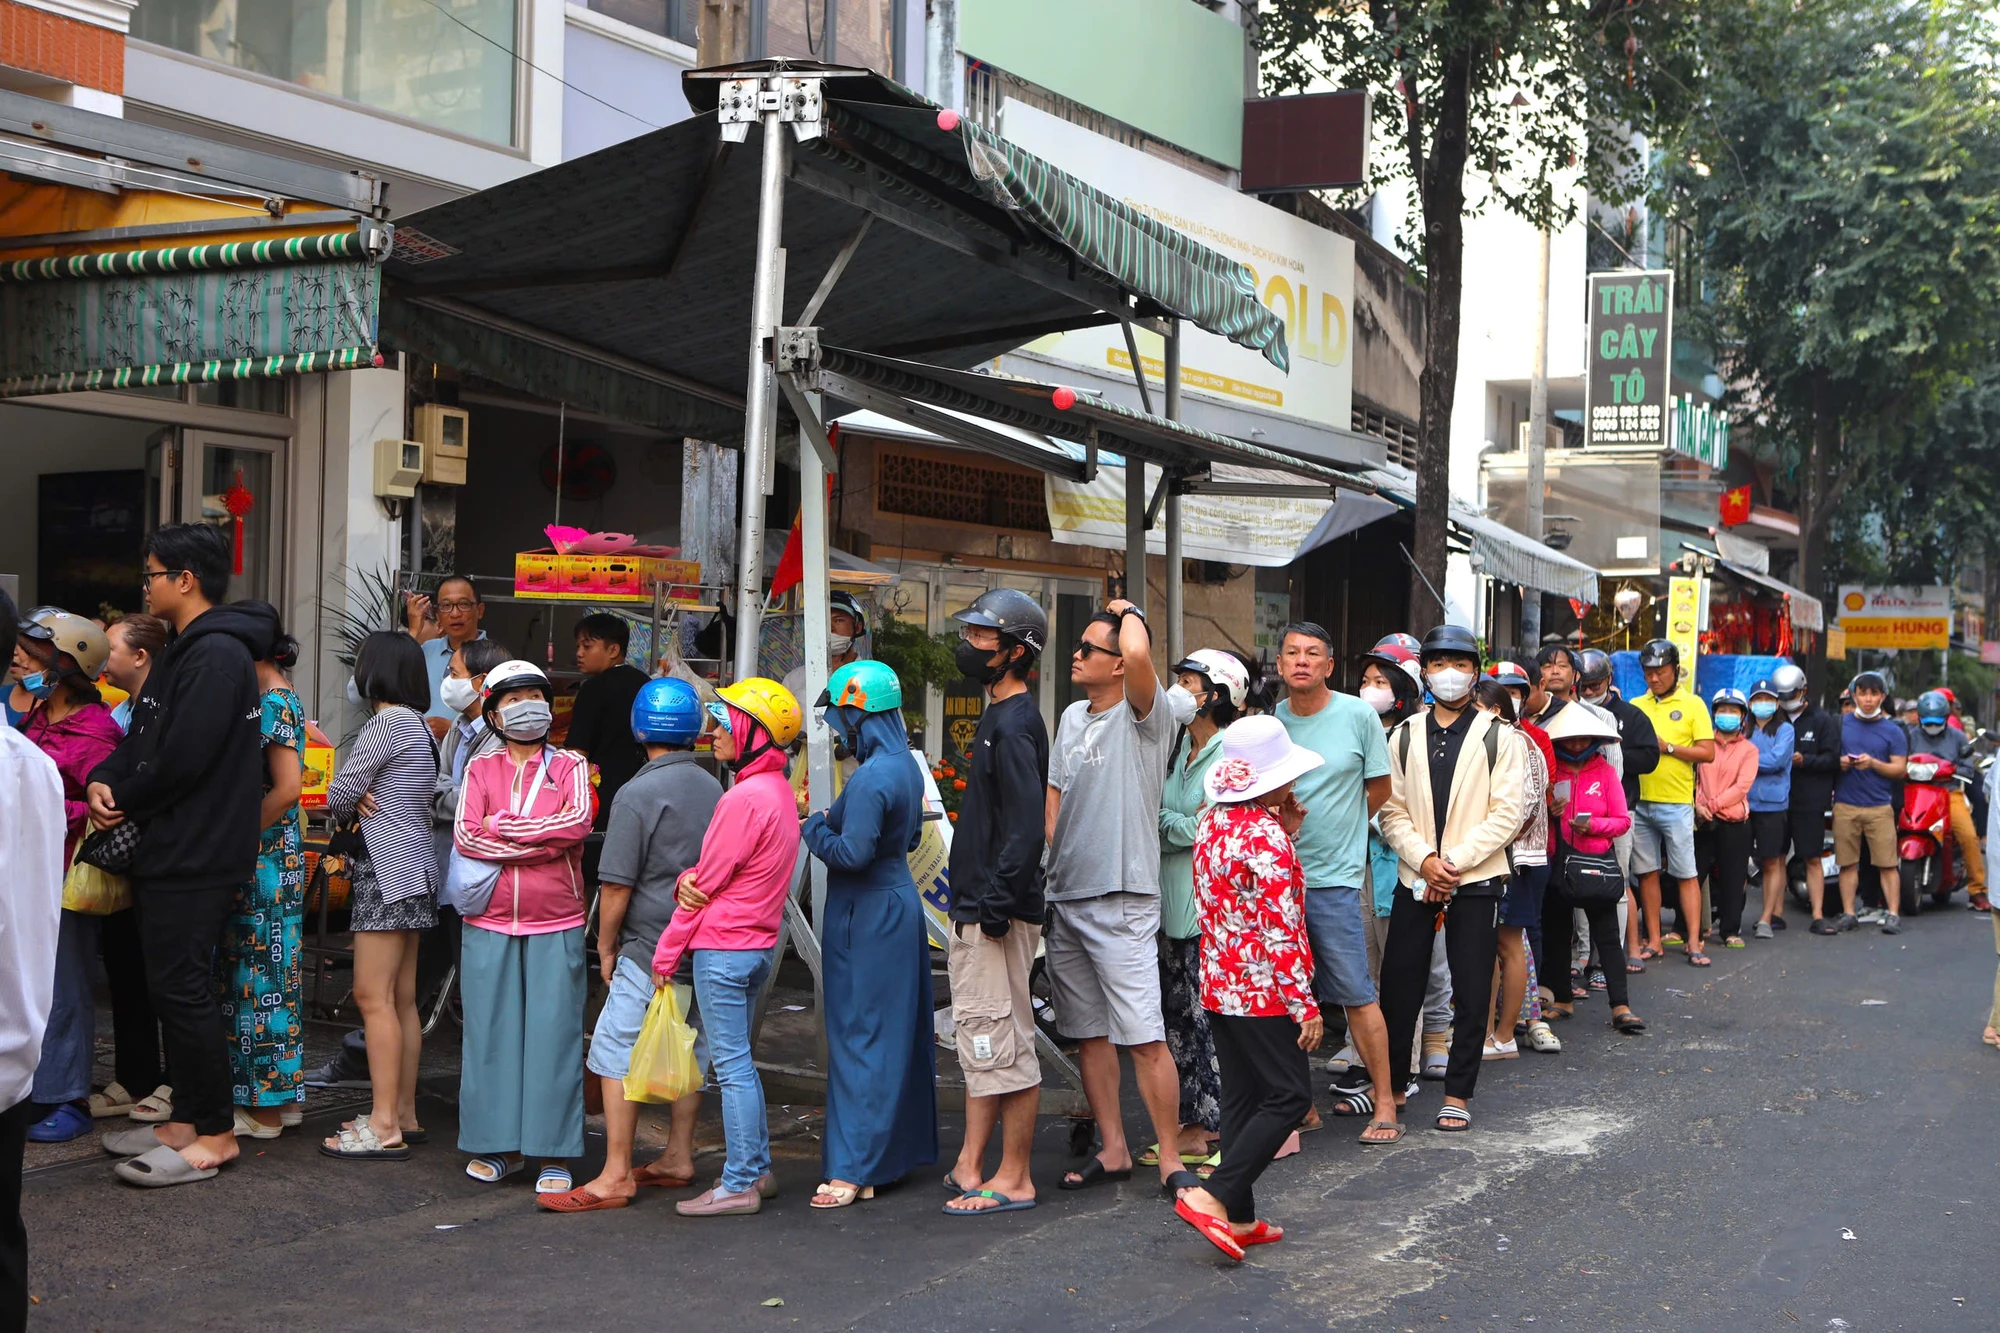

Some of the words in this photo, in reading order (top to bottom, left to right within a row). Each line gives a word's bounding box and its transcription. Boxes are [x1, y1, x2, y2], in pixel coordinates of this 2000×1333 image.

[1241, 262, 1347, 367] OLD
[1598, 277, 1664, 315] TRÁI
[1600, 322, 1658, 360] CÂY
[1610, 366, 1646, 404] TÔ
[1620, 418, 1639, 430] 124
[967, 696, 982, 715] GOLD
[928, 855, 942, 871] STEEL
